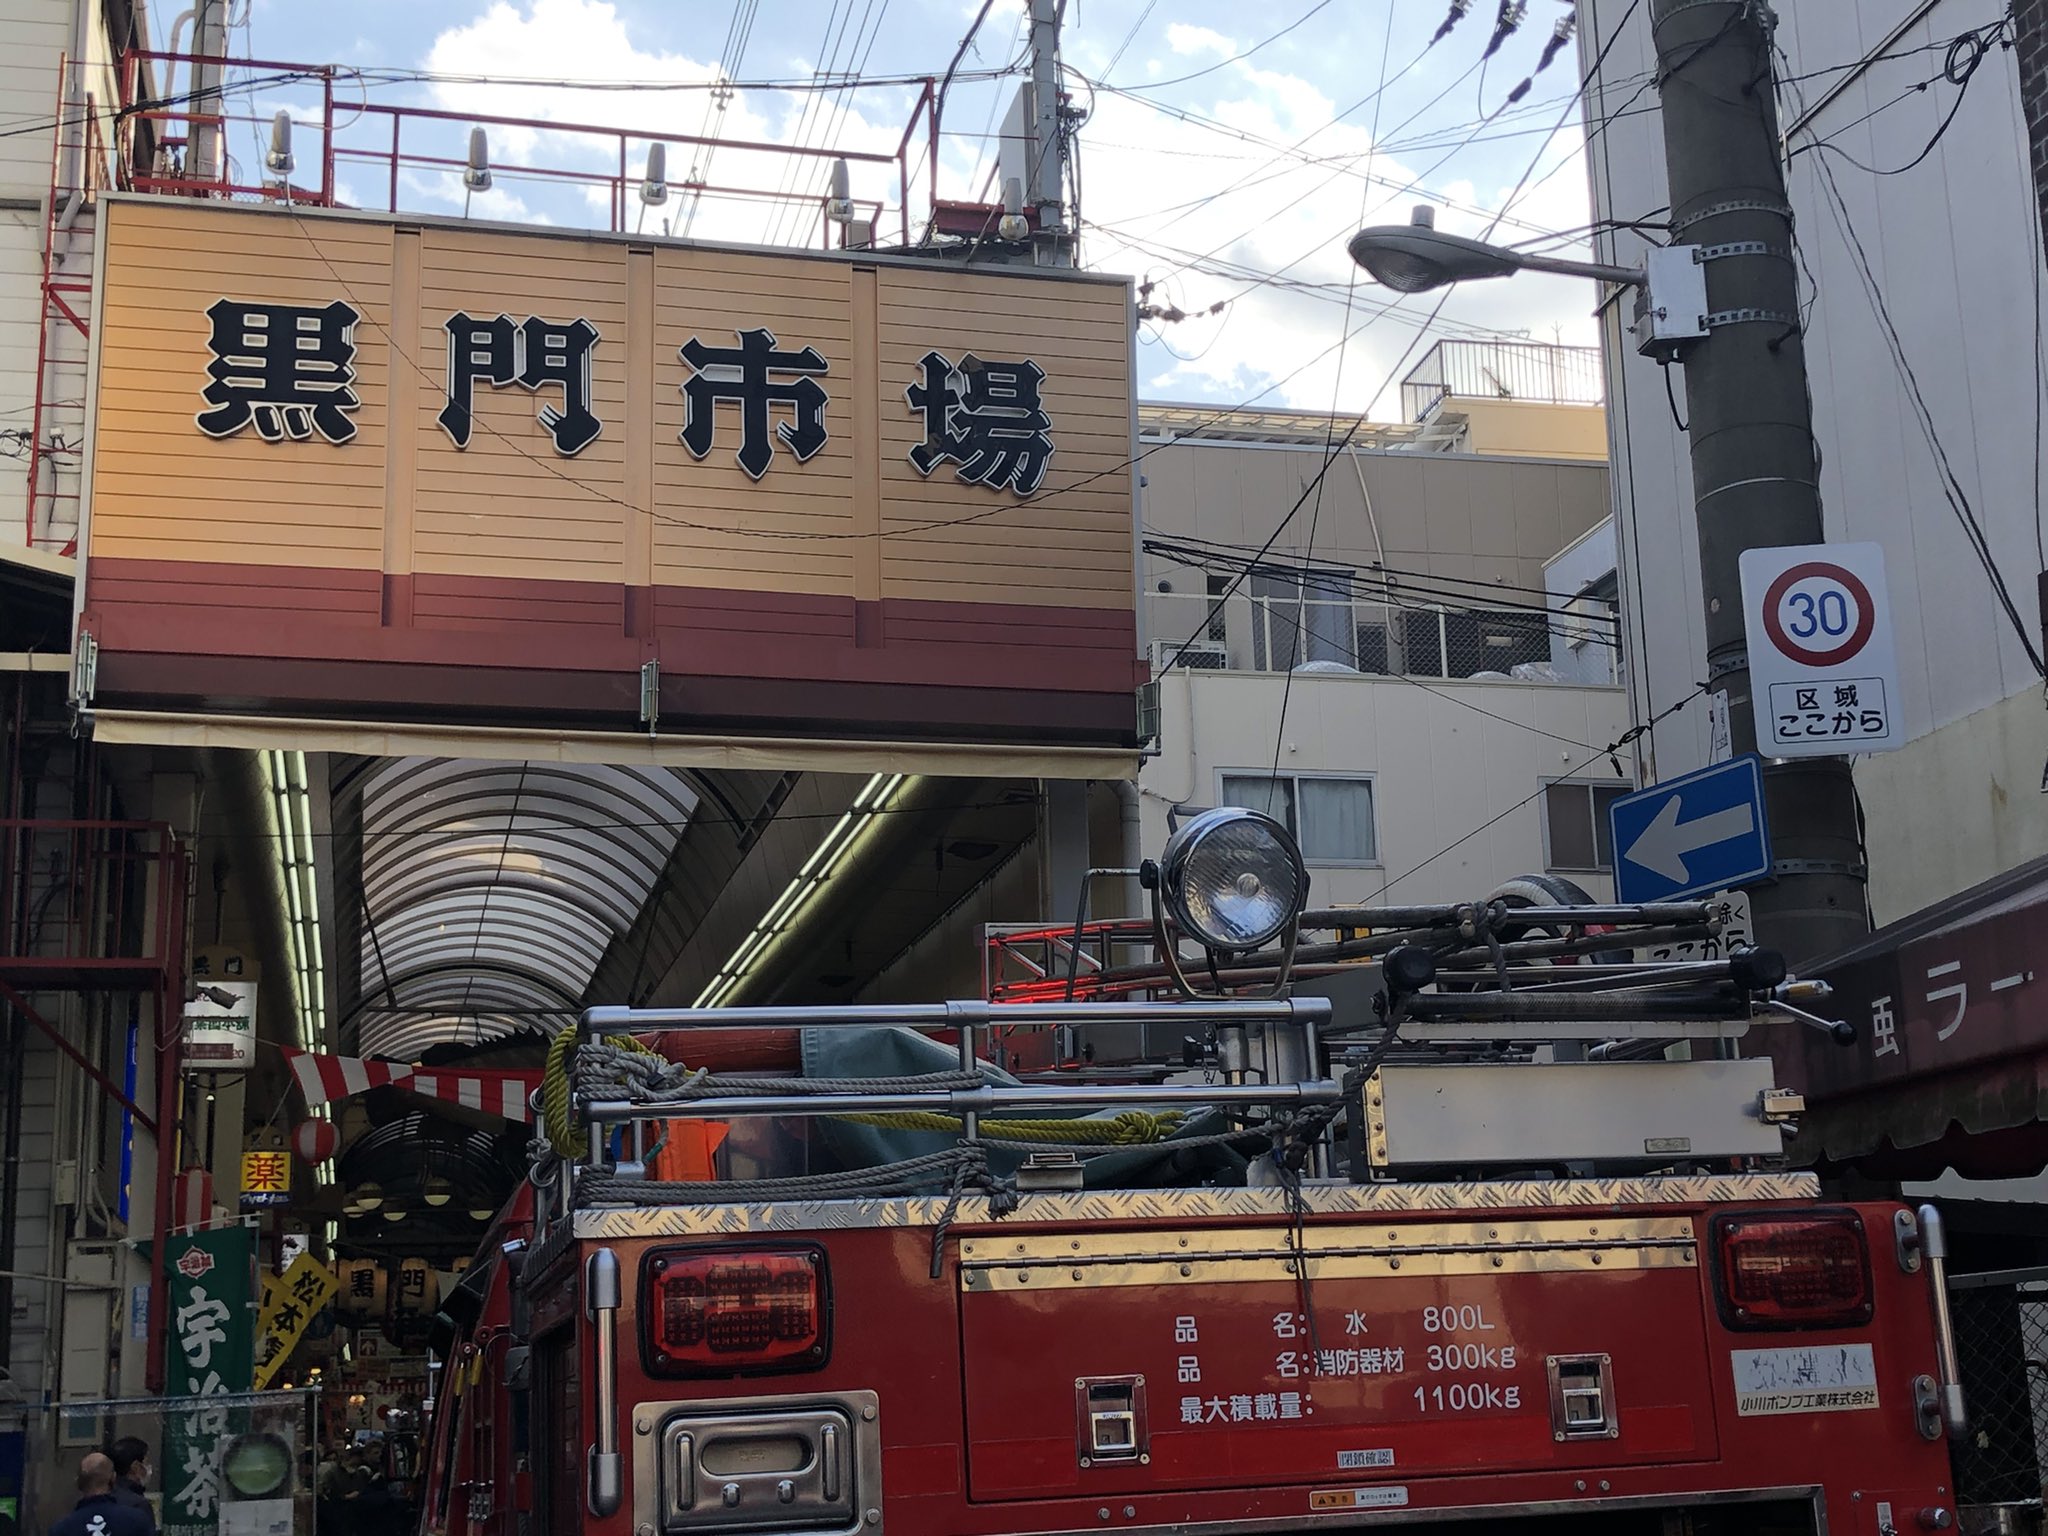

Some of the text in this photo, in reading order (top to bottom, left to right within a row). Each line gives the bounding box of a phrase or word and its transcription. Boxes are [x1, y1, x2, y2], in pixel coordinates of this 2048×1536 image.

[194, 297, 1056, 499] 黒門市場
[1788, 590, 1848, 638] 30
[1796, 685, 1859, 710] 区域
[1779, 709, 1885, 738] ここから
[247, 1154, 285, 1190] 薬
[1175, 1315, 1198, 1343] 品
[1345, 1309, 1368, 1335] 水
[1423, 1305, 1495, 1333] 800L
[1177, 1355, 1201, 1383] 品
[1427, 1344, 1516, 1372] 300kg
[173, 1285, 231, 1518] 宇治茶
[1179, 1384, 1521, 1424] 最大積載量: 1100kg
[1741, 1390, 1875, 1411] 小川ポンプ工業株式会社
